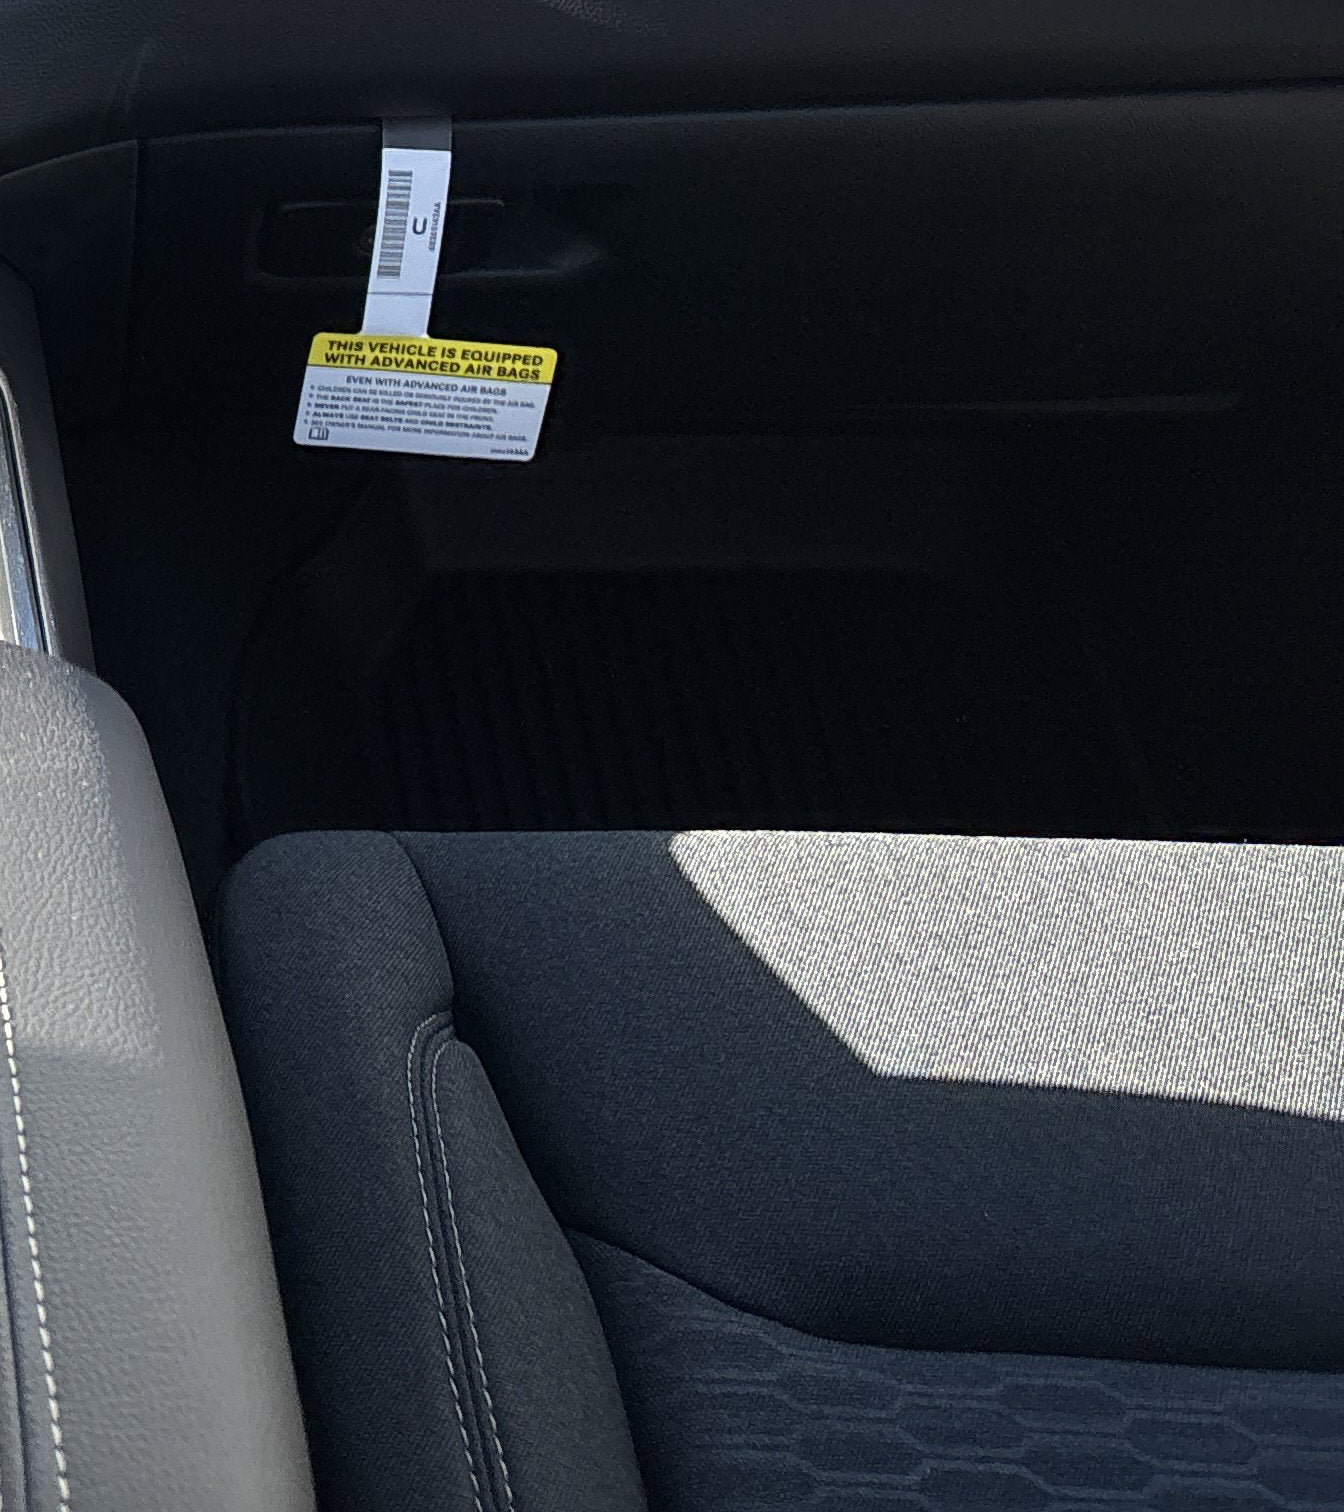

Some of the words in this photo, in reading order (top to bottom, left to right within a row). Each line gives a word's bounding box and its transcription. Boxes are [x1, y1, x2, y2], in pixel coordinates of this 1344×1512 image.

[324, 353, 366, 366] WITH
[370, 356, 461, 373] ADVANCED
[464, 363, 493, 376] AIR
[497, 366, 541, 380] BAGS
[328, 340, 363, 352] THIS
[368, 342, 436, 357] VEHICLE
[441, 347, 455, 359] IS
[461, 348, 543, 367] EQUIPPED
[346, 375, 372, 385] EVEN
[375, 377, 400, 387] WITH
[403, 380, 458, 392] ADVANCED
[460, 384, 478, 394] AIR
[480, 385, 507, 396] BAGS
